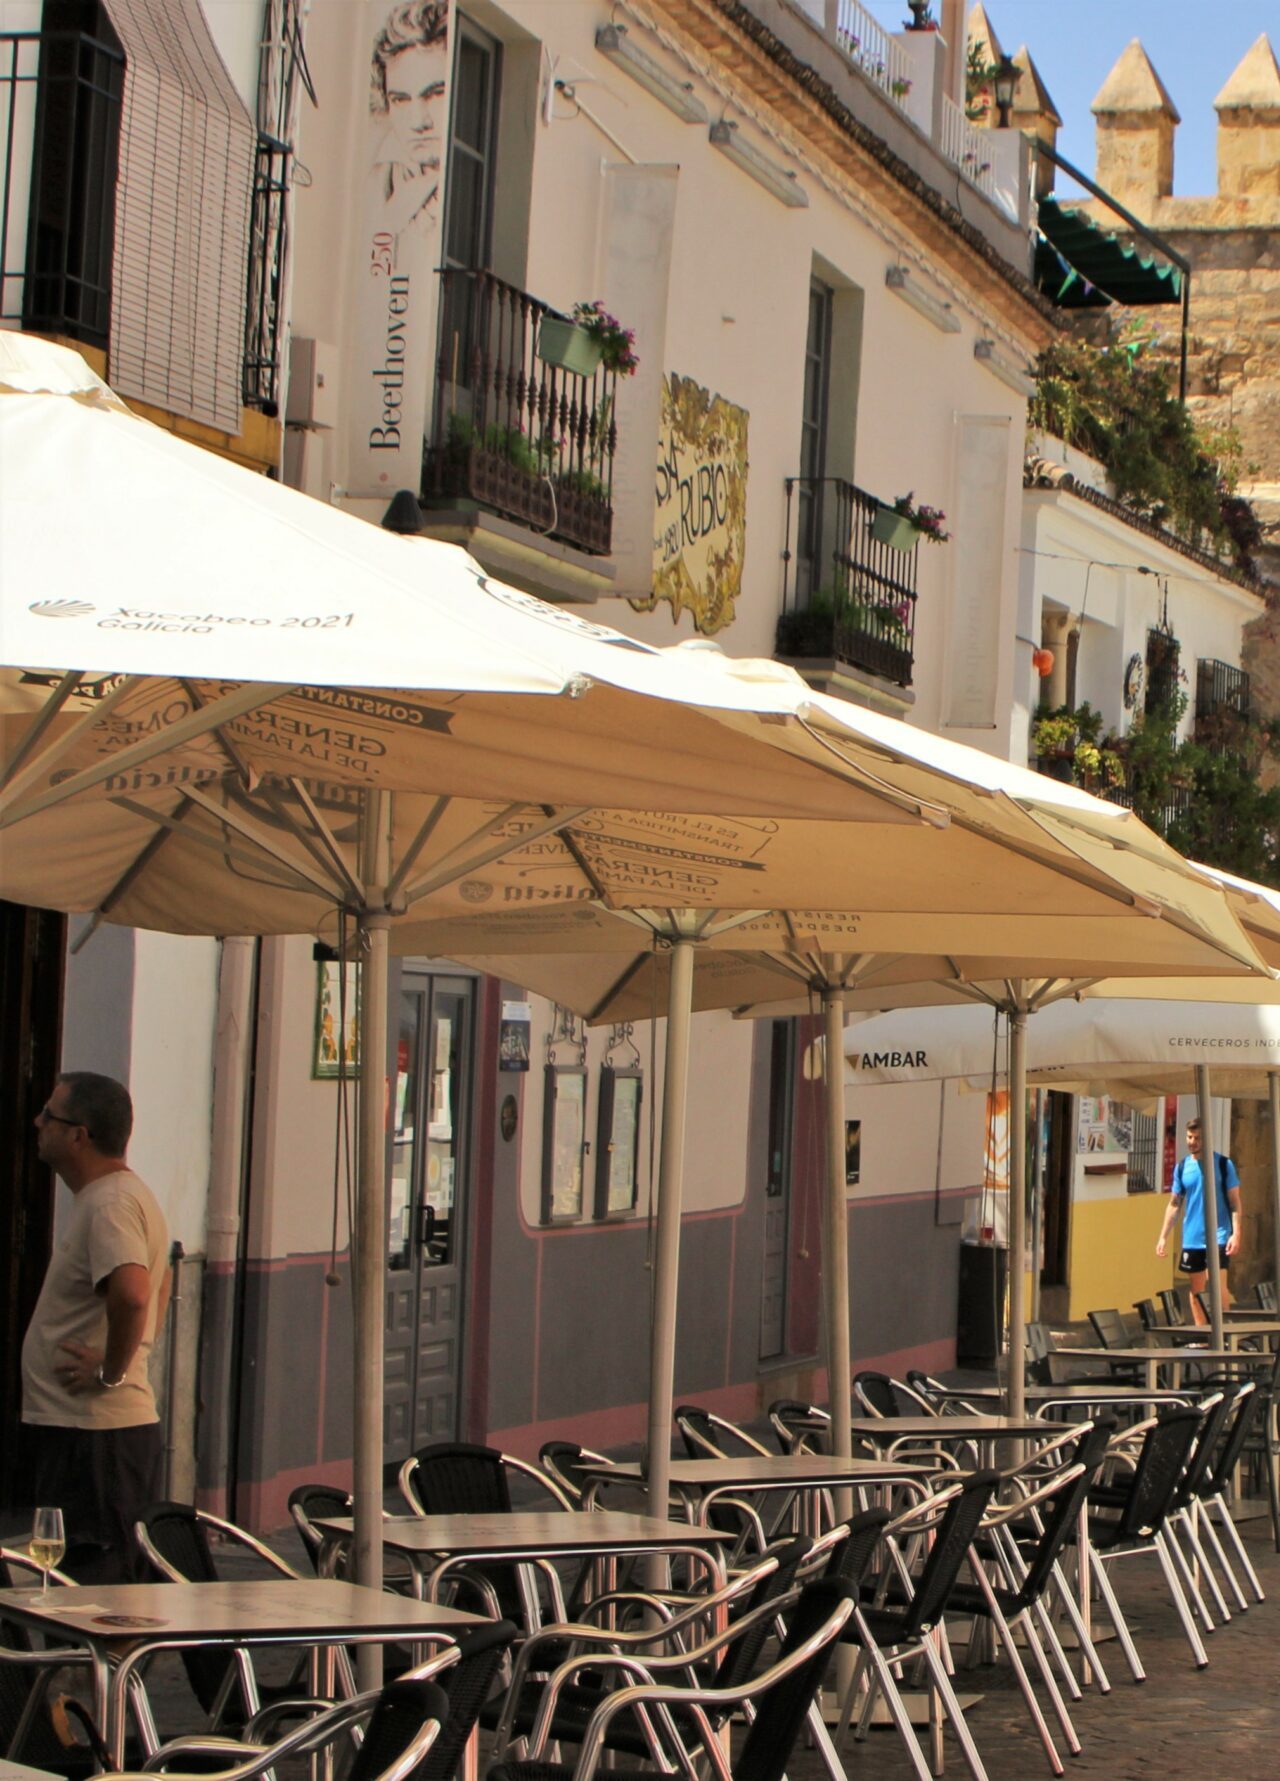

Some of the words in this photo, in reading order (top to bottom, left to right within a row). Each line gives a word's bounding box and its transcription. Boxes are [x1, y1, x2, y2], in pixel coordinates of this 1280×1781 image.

[370, 232, 393, 276] 250
[369, 274, 409, 452] Beethoven
[681, 463, 728, 547] RUBIO
[97, 618, 215, 634] Galicia
[111, 607, 271, 627] Xacobeo
[280, 613, 355, 629] 2021
[1169, 1037, 1250, 1048] CERVECEROS
[861, 1050, 928, 1070] AMBAR
